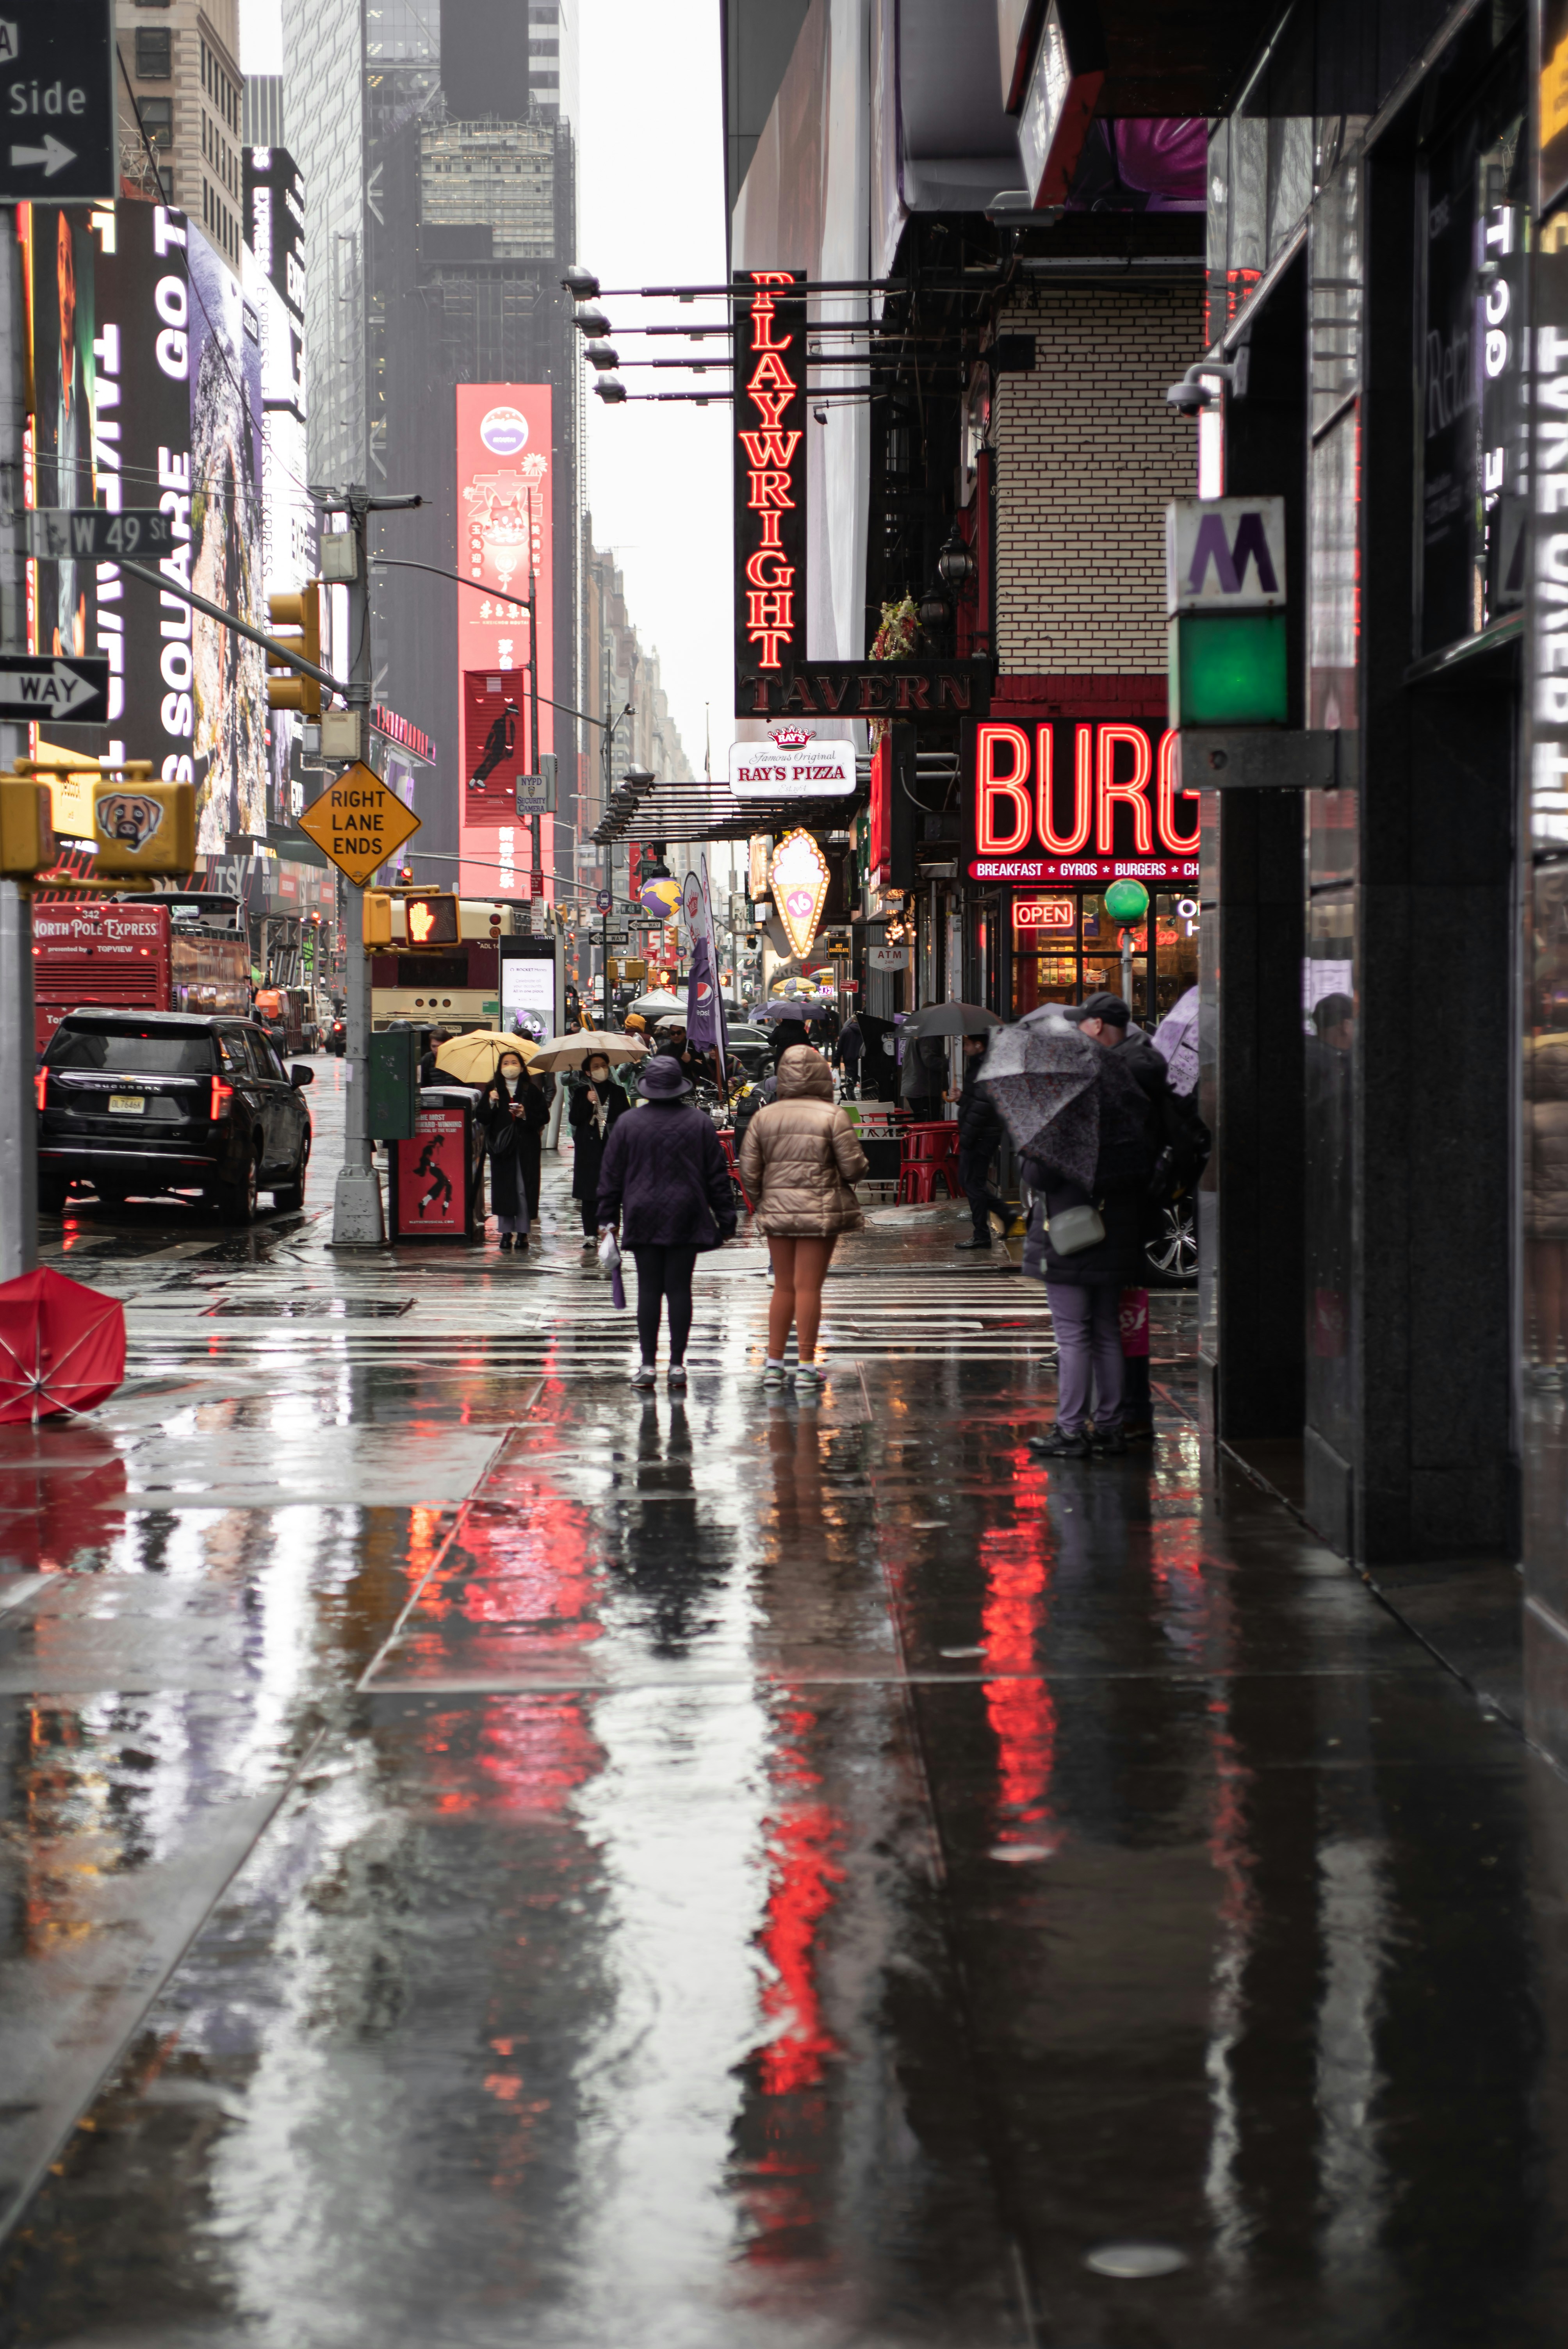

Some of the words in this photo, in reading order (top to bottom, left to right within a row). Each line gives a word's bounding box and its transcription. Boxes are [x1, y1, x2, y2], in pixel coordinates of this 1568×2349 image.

[10, 80, 86, 114] Side
[253, 186, 271, 274] EXPRESS
[155, 275, 189, 379] GO
[739, 272, 803, 668] PLAYWRIGHT
[73, 517, 95, 552] W
[107, 517, 140, 553] 49
[150, 517, 167, 540] St
[158, 446, 192, 736] SQUARE
[21, 677, 78, 702] WAY
[739, 674, 973, 712] TAVERN
[778, 734, 805, 742] RAY'S
[749, 752, 791, 765] Famous
[794, 750, 836, 764] Original
[738, 765, 787, 782] RAY'S
[792, 765, 847, 781] PIZZA
[331, 791, 385, 807] RIGHT
[332, 814, 384, 831] LANE
[334, 838, 383, 854] ENDS
[977, 863, 1043, 876] BREAKFAST
[1060, 863, 1098, 876] GYROS
[1115, 863, 1166, 876] BURGERS
[621, 905, 625, 913] W
[627, 905, 635, 913] 48
[788, 893, 811, 915] 16
[82, 910, 100, 919] 342
[1018, 907, 1068, 923] OPEN
[71, 919, 103, 938] POLE
[104, 919, 157, 939] EXPRESS
